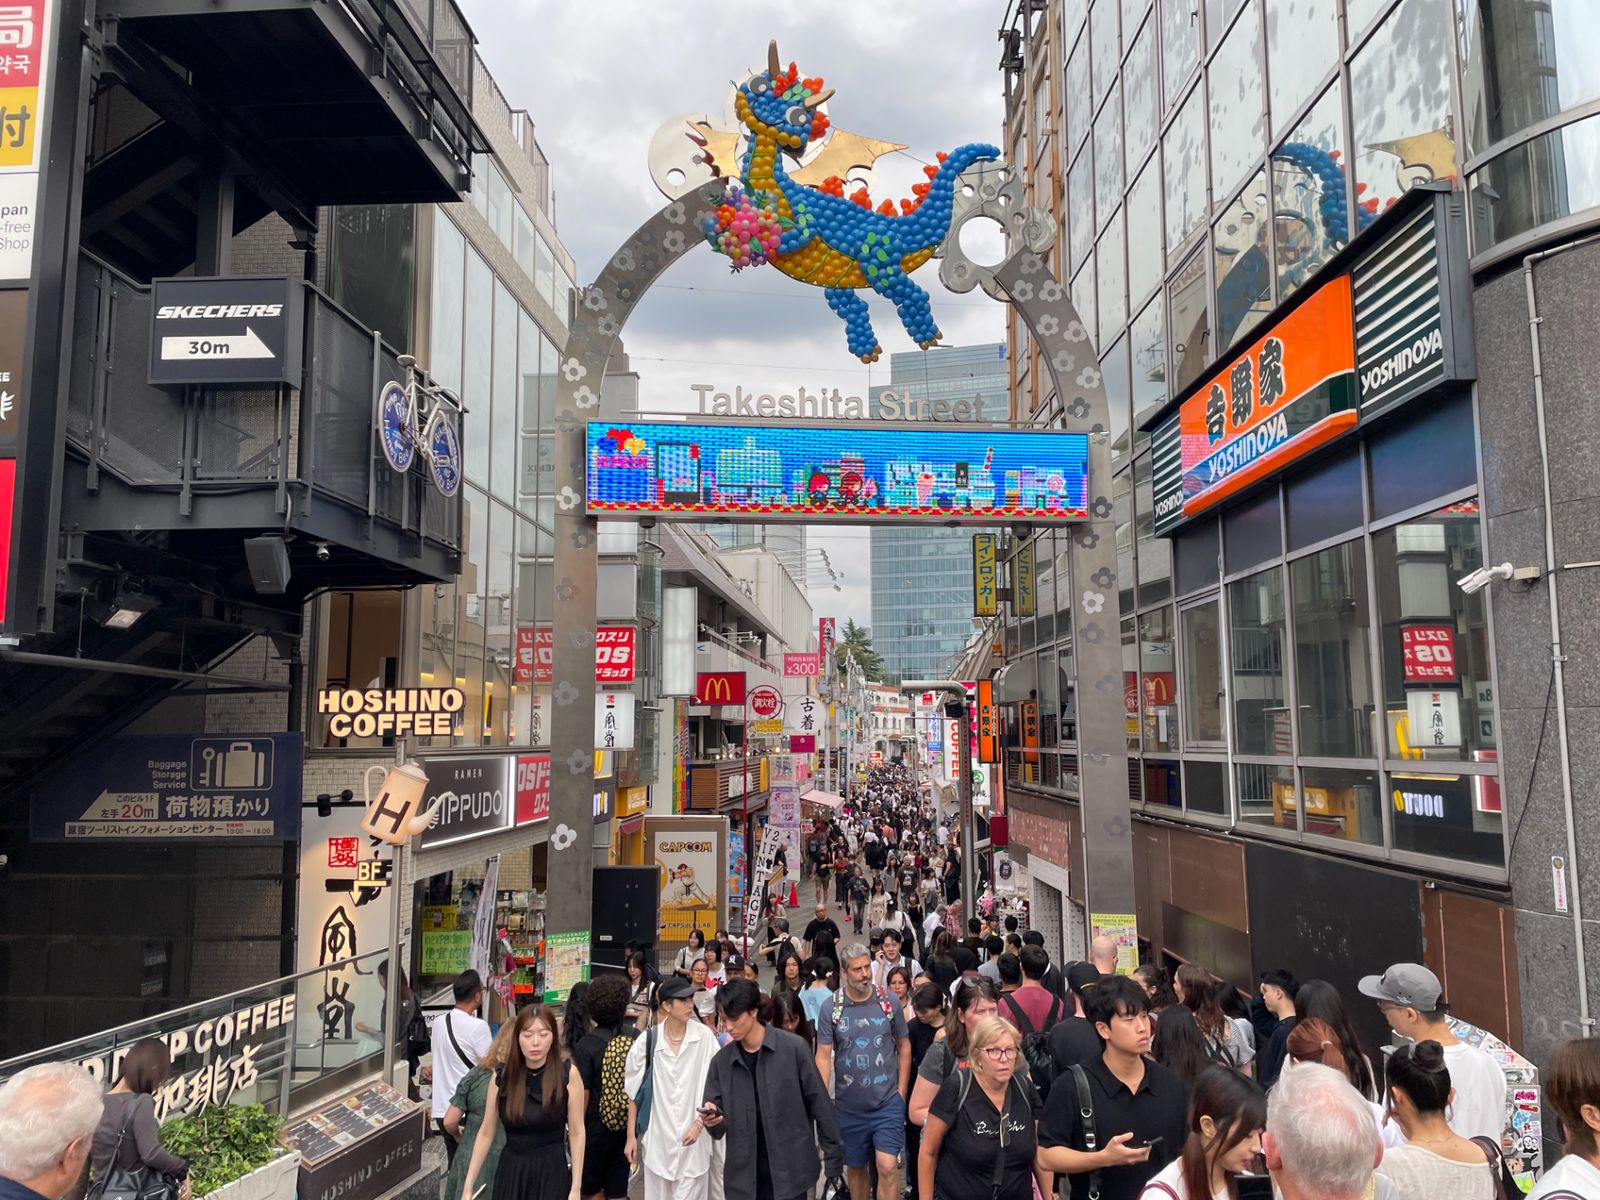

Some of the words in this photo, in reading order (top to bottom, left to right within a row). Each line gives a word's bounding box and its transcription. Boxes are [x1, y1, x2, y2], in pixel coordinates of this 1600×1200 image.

[156, 303, 284, 320] SKECHERS
[188, 340, 231, 356] 30m
[1361, 327, 1443, 396] YOSHINOYA
[690, 383, 864, 421] Takeshita
[878, 389, 989, 424] Street
[1205, 335, 1287, 448] 吉野家
[1207, 412, 1289, 483] YOSHINOYA
[978, 535, 994, 606] コインロッカー
[595, 646, 632, 664] OS
[318, 688, 464, 714] HOSHINO
[330, 713, 453, 738] COFFEE
[800, 698, 816, 731] 古着
[951, 721, 959, 780] COFFEE
[148, 760, 187, 770] Baggage
[152, 770, 187, 780] Storage
[454, 768, 484, 780] RAMEN
[153, 780, 186, 789] Service
[165, 795, 271, 819] 荷物預かり
[659, 841, 713, 853] CAPCOM
[747, 827, 772, 928] VINTAGE
[194, 994, 296, 1054] COFFEE
[375, 1138, 414, 1173] COFFEE
